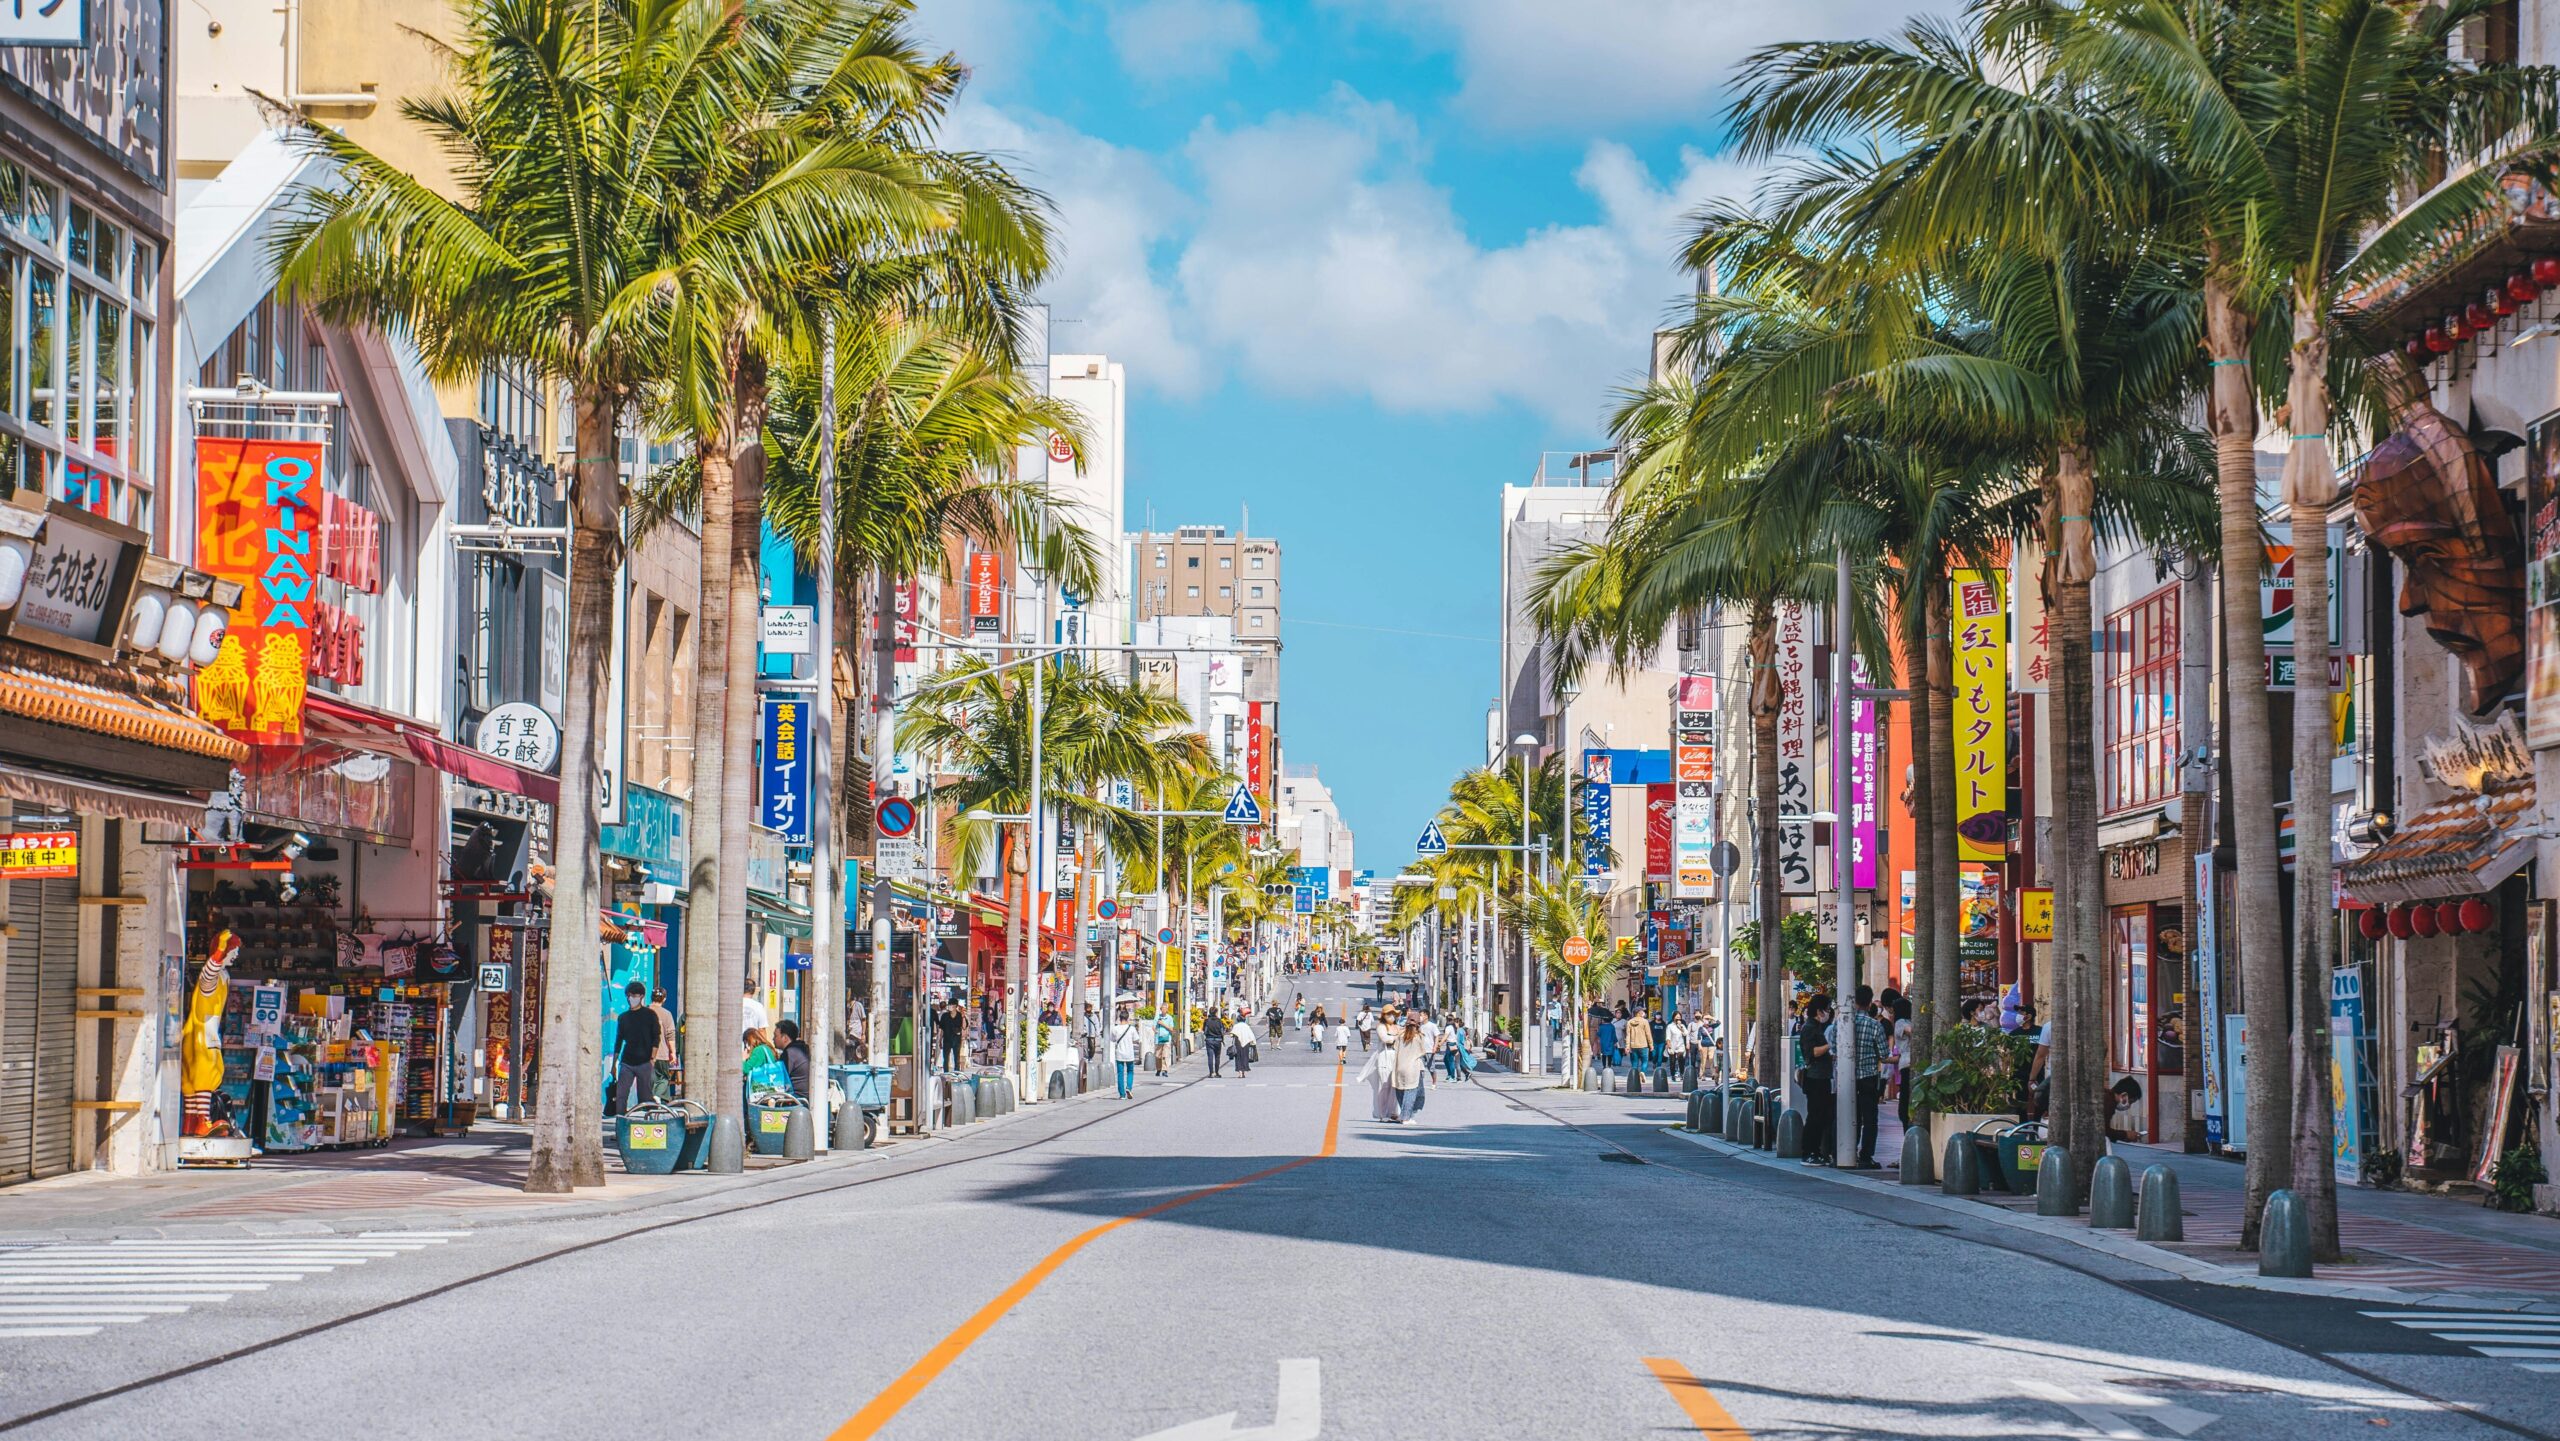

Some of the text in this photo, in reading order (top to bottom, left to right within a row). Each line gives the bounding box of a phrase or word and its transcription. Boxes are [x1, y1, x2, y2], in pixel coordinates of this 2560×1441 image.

[1053, 437, 1070, 457] 福
[259, 457, 313, 629] OKINAWA
[46, 543, 109, 612] ちぬまん
[1967, 582, 1998, 616] 元祖
[495, 713, 538, 738] 首里
[1961, 622, 1998, 809] 紅いもタルト
[491, 738, 541, 764] 石鹸
[773, 703, 796, 831] 英会話イーオン
[1778, 601, 1811, 884] 泡盛と沖縄地料理 あかはち
[1566, 945, 1588, 956] 消火栓
